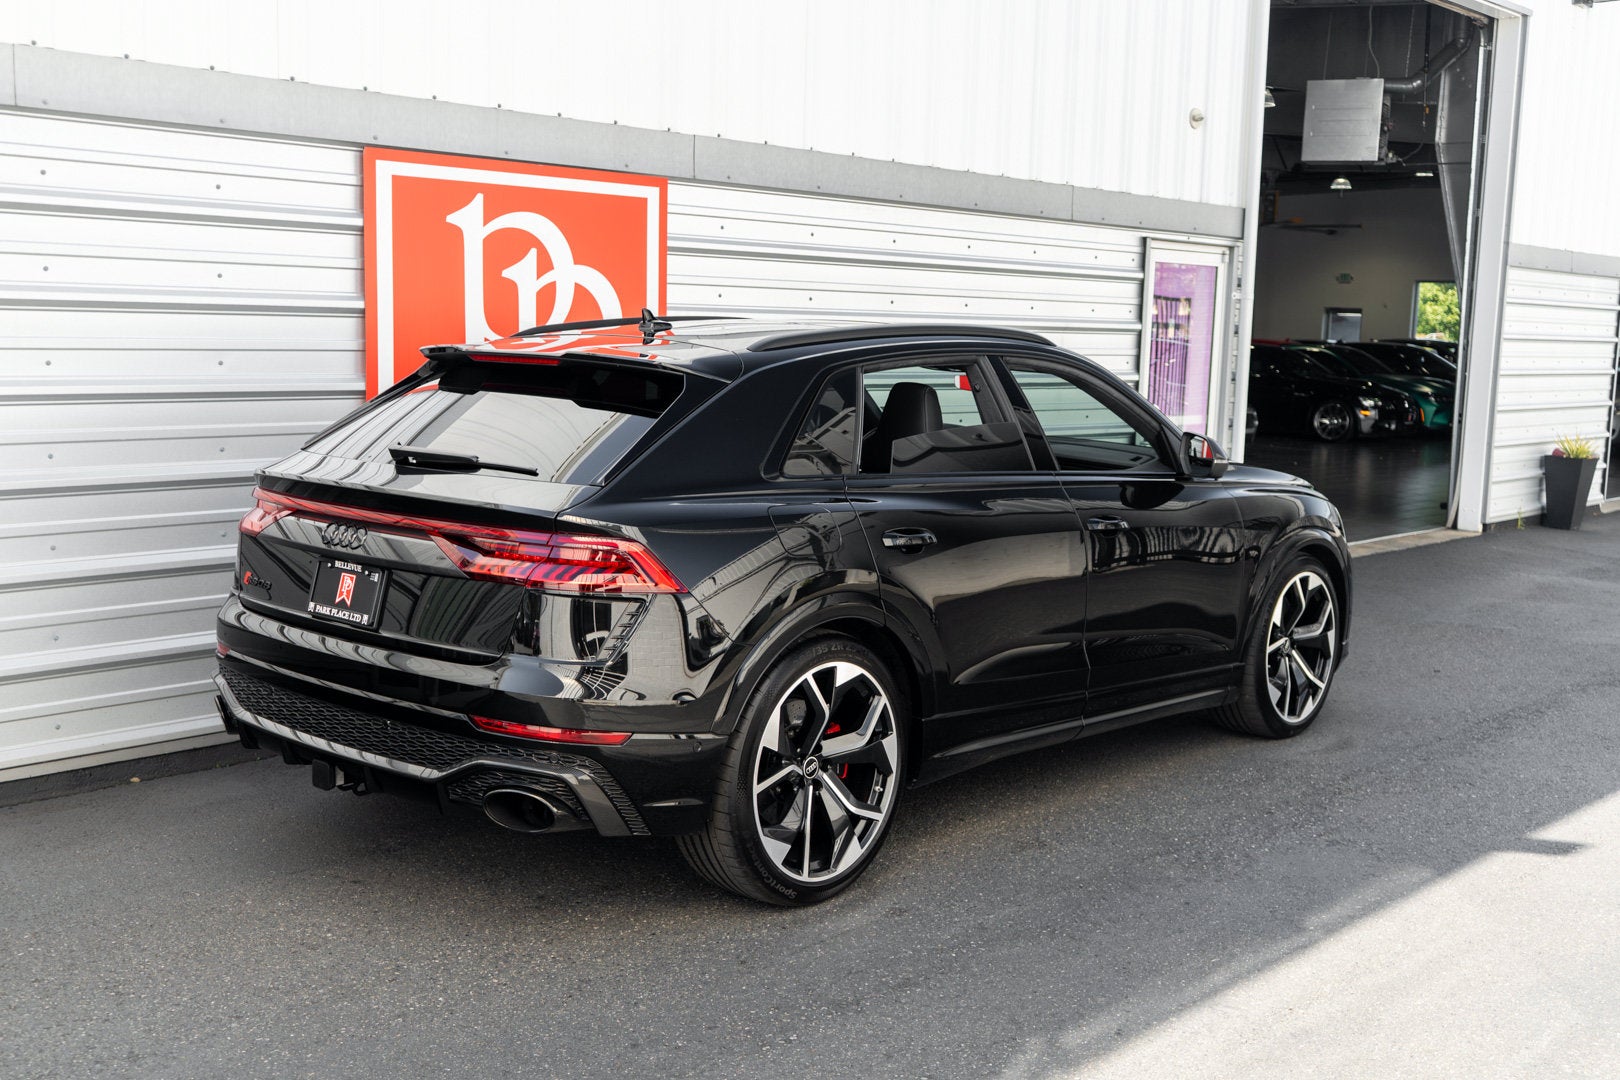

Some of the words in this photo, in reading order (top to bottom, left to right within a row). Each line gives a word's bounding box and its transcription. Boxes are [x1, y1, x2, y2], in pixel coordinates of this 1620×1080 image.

[335, 560, 362, 572] BELLEVUE
[316, 604, 330, 615] PARK
[331, 608, 349, 619] PLACE
[350, 613, 361, 623] LTD
